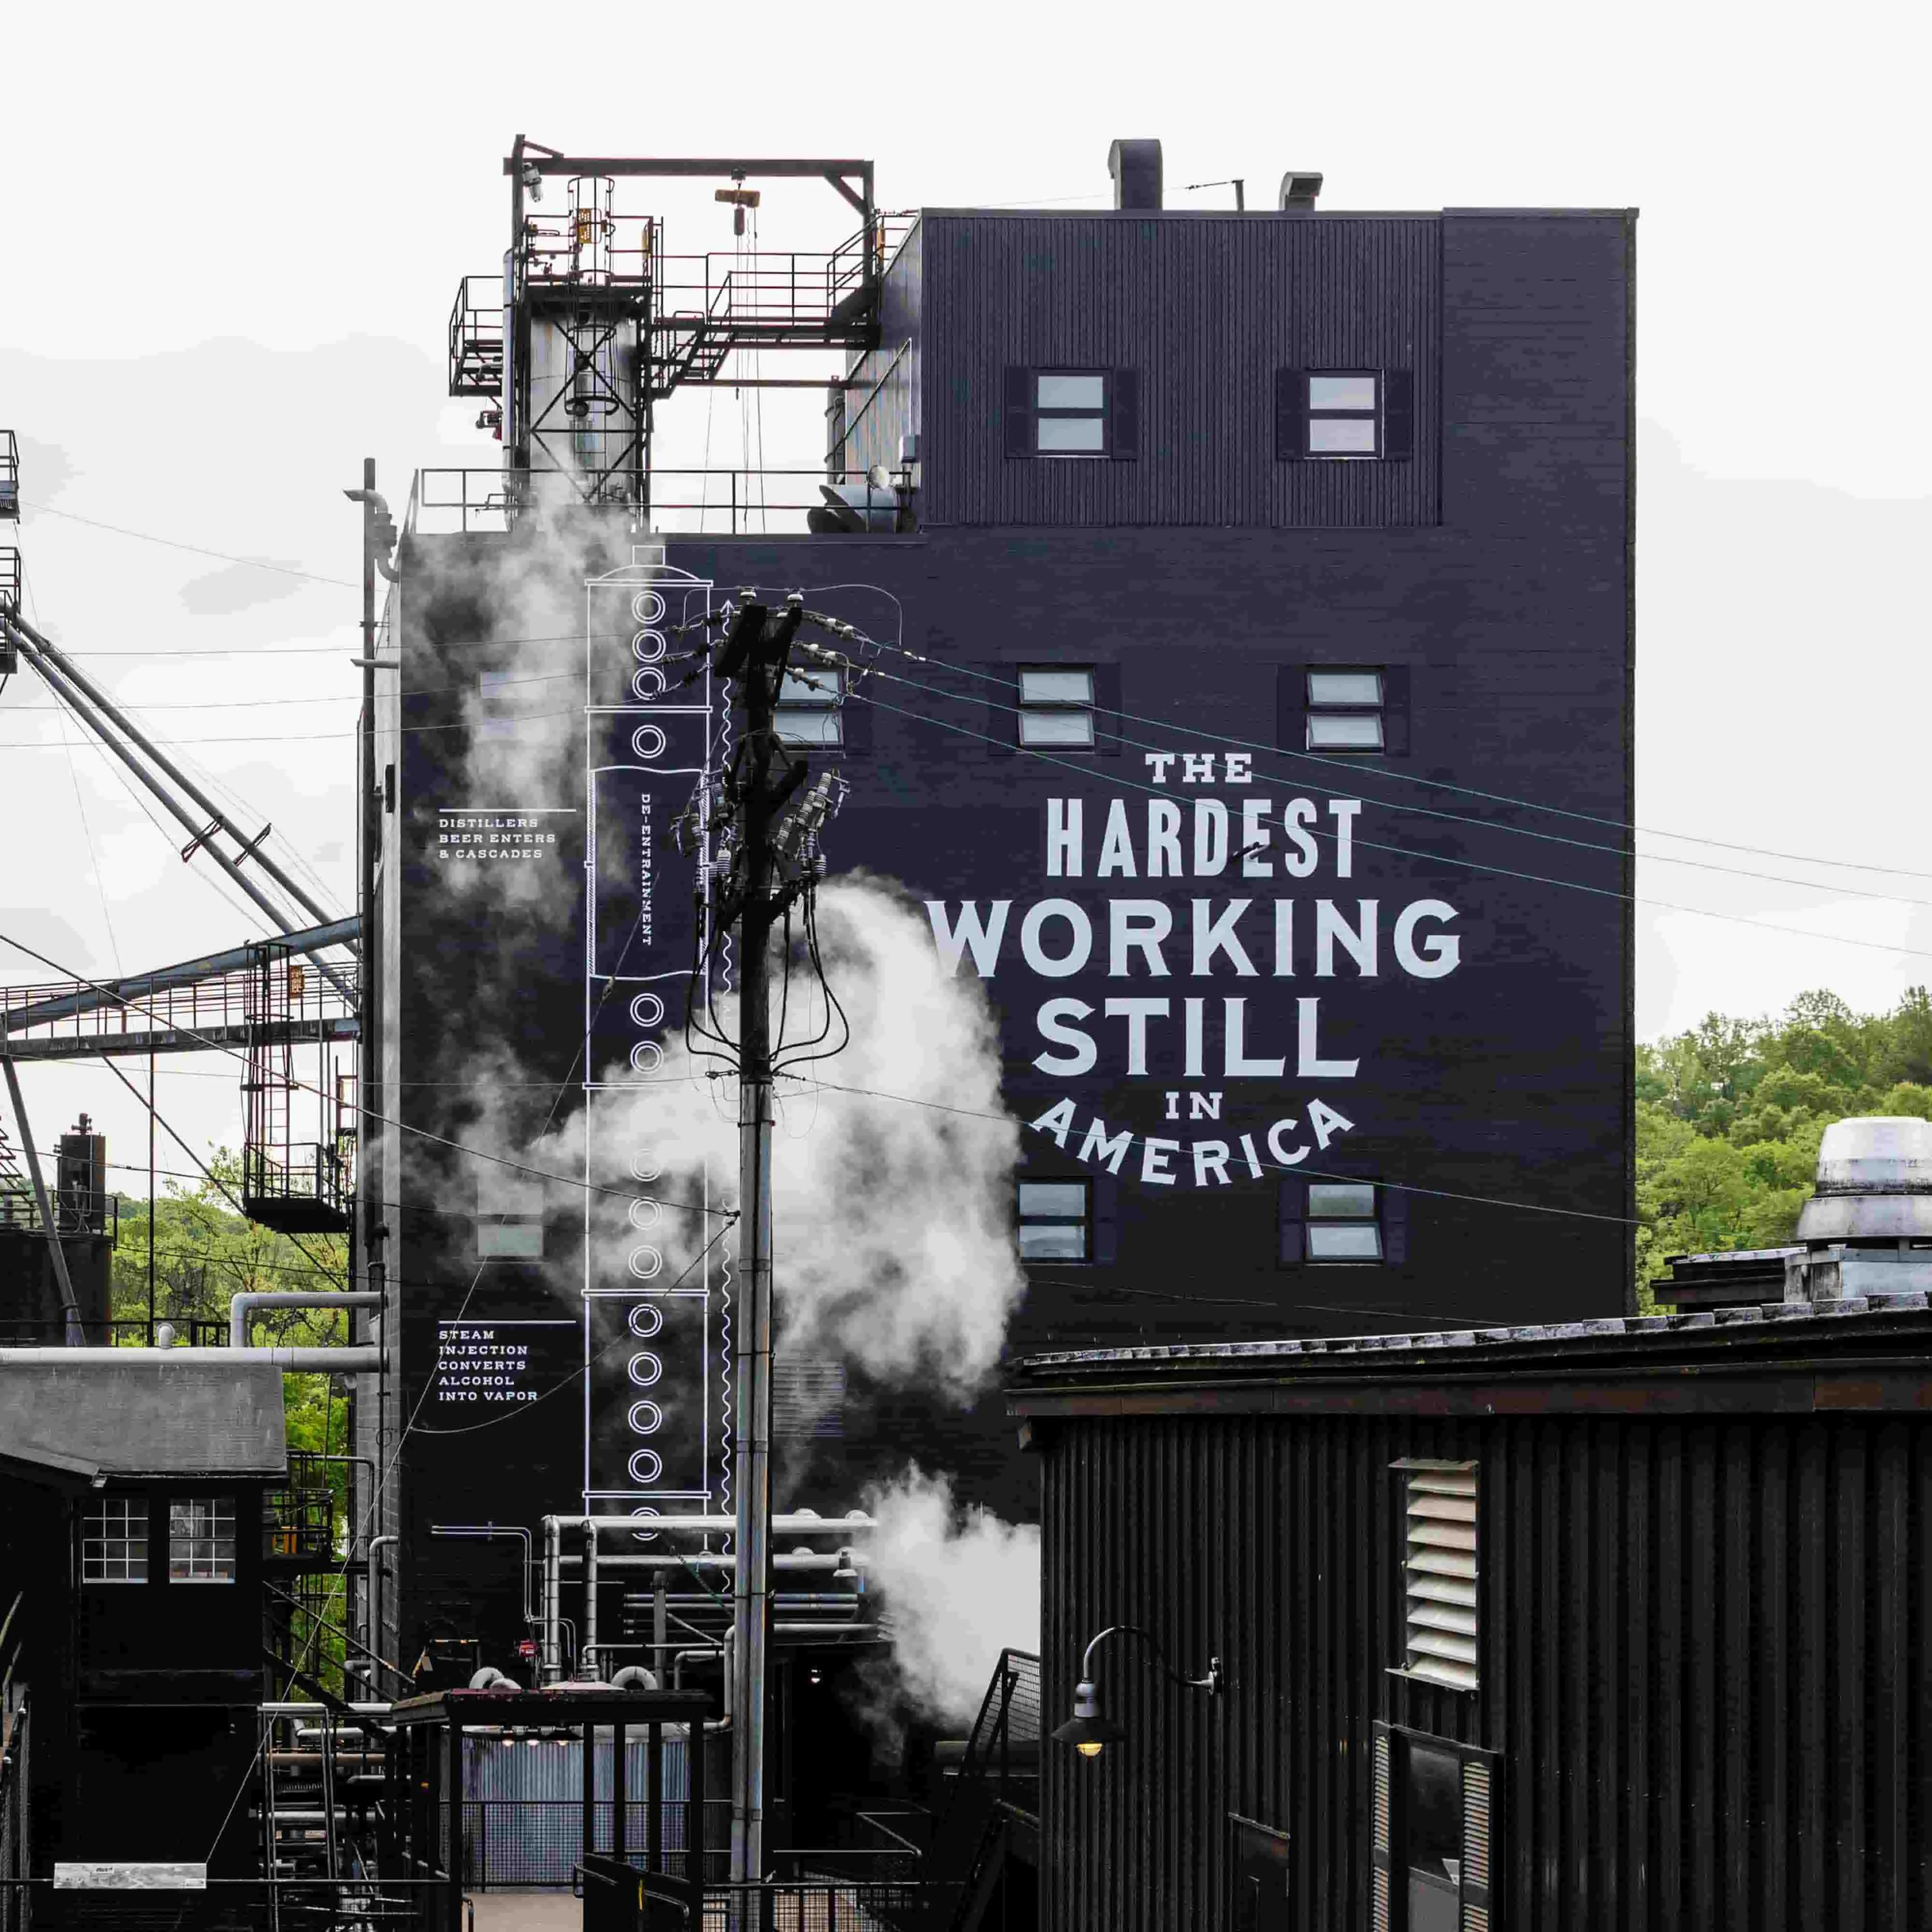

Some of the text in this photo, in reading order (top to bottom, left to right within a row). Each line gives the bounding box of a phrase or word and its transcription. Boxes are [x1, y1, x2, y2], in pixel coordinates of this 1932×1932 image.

[1145, 753, 1252, 783] THE
[439, 819, 538, 828] DISTILLERS
[439, 834, 556, 843] BEER ENTERS
[1046, 797, 1362, 879] HARDEST
[439, 850, 542, 858] & CASCADES
[641, 793, 652, 946] DE-ENTRAINMENT
[924, 898, 1461, 979] WORKING
[1032, 996, 1360, 1078] STILL
[1165, 1091, 1223, 1120] IN
[1029, 1097, 1354, 1187] AMERICA
[439, 1330, 495, 1340] STEAM
[439, 1346, 528, 1355] INJECTION
[439, 1361, 526, 1370] CONVERTS
[439, 1376, 514, 1386] ALCOHOL
[439, 1392, 537, 1401] INTO VAPOR
